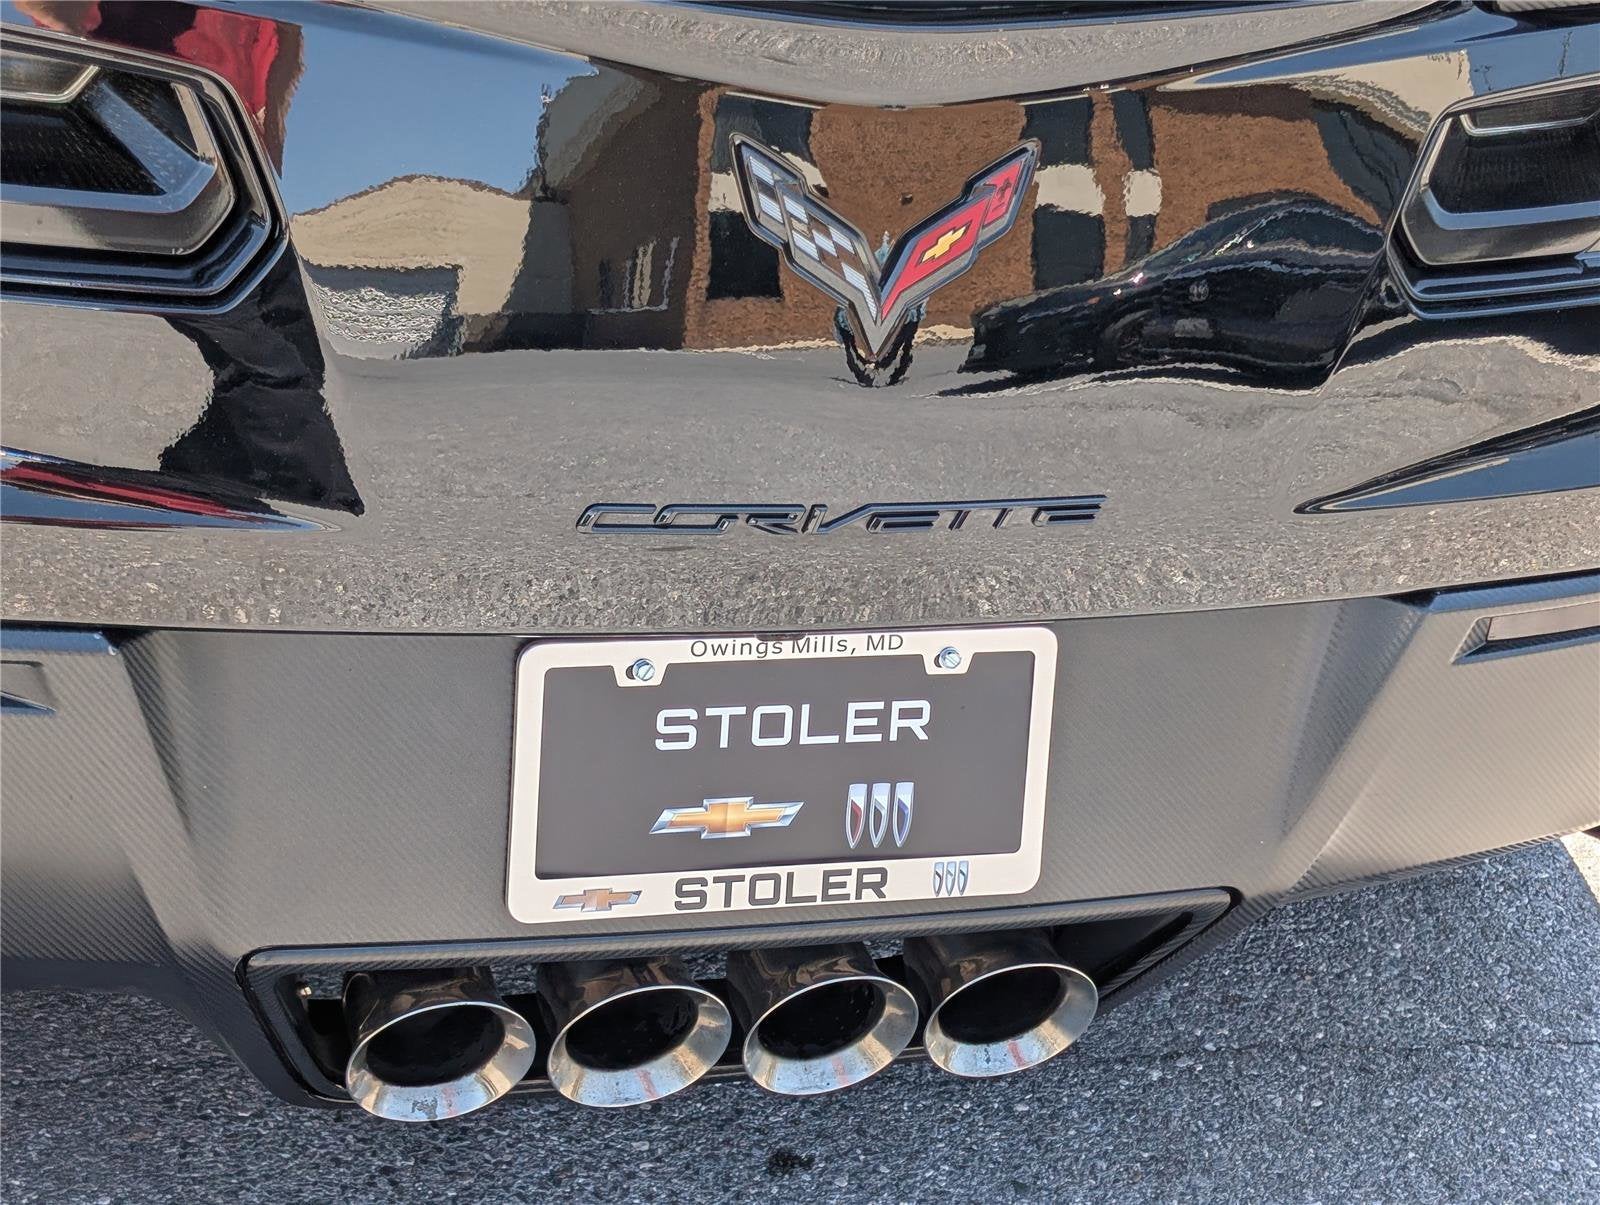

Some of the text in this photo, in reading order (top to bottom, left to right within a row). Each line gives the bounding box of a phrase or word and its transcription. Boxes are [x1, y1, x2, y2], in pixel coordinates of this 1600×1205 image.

[575, 494, 1108, 535] CORVETTE
[690, 634, 904, 659] Owings Mills, MD
[655, 700, 931, 751] STOLER
[674, 866, 888, 911] STOLER
